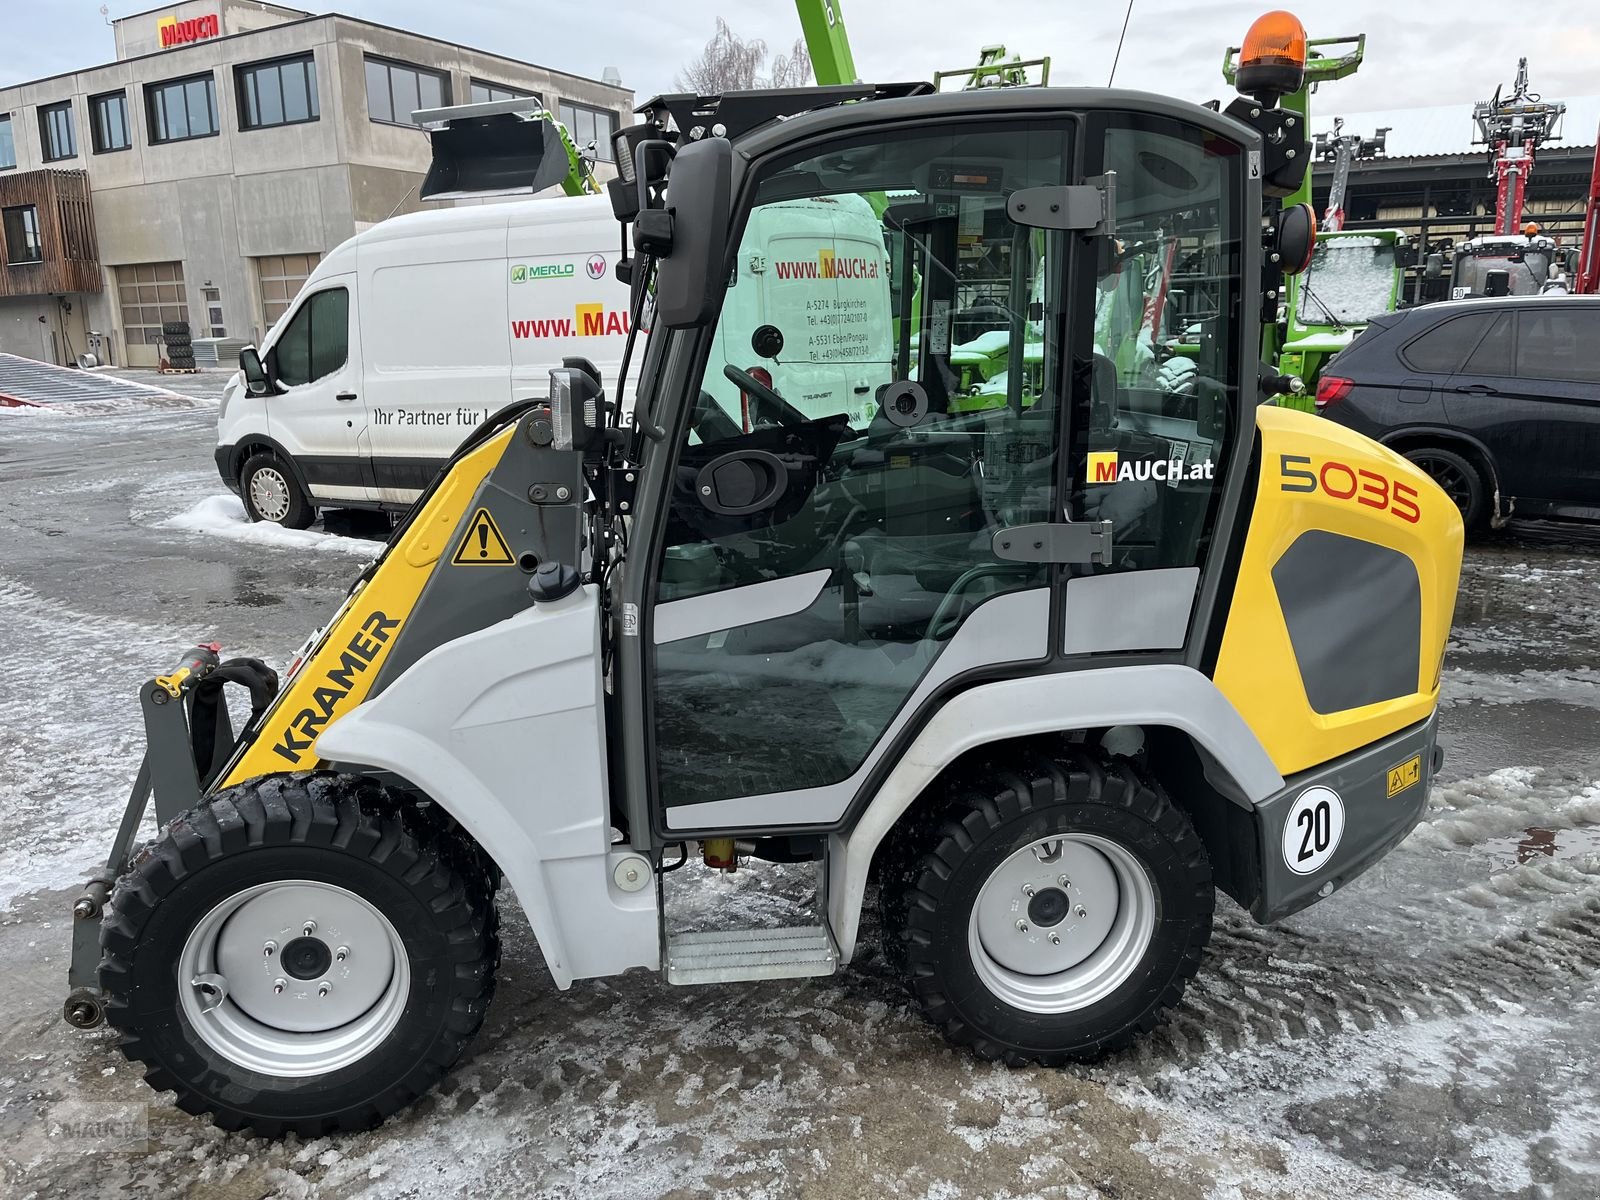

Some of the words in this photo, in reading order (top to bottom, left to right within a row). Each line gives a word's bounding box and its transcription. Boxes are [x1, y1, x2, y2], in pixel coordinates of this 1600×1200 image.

[161, 14, 219, 47] MAUCH
[529, 264, 574, 276] MERLO
[775, 257, 879, 279] www.MAUCH.at
[1453, 288, 1464, 298] 30
[806, 300, 829, 310] A-5274
[833, 299, 866, 311] Burgkirchen
[809, 335, 831, 346] A-5531
[374, 408, 393, 425] Ihr
[397, 408, 451, 425] Partner
[456, 408, 479, 425] für
[1095, 459, 1214, 482] MAUCH.at
[1280, 454, 1421, 524] 5035
[272, 610, 402, 764] KRAMER
[1297, 800, 1331, 863] 20
